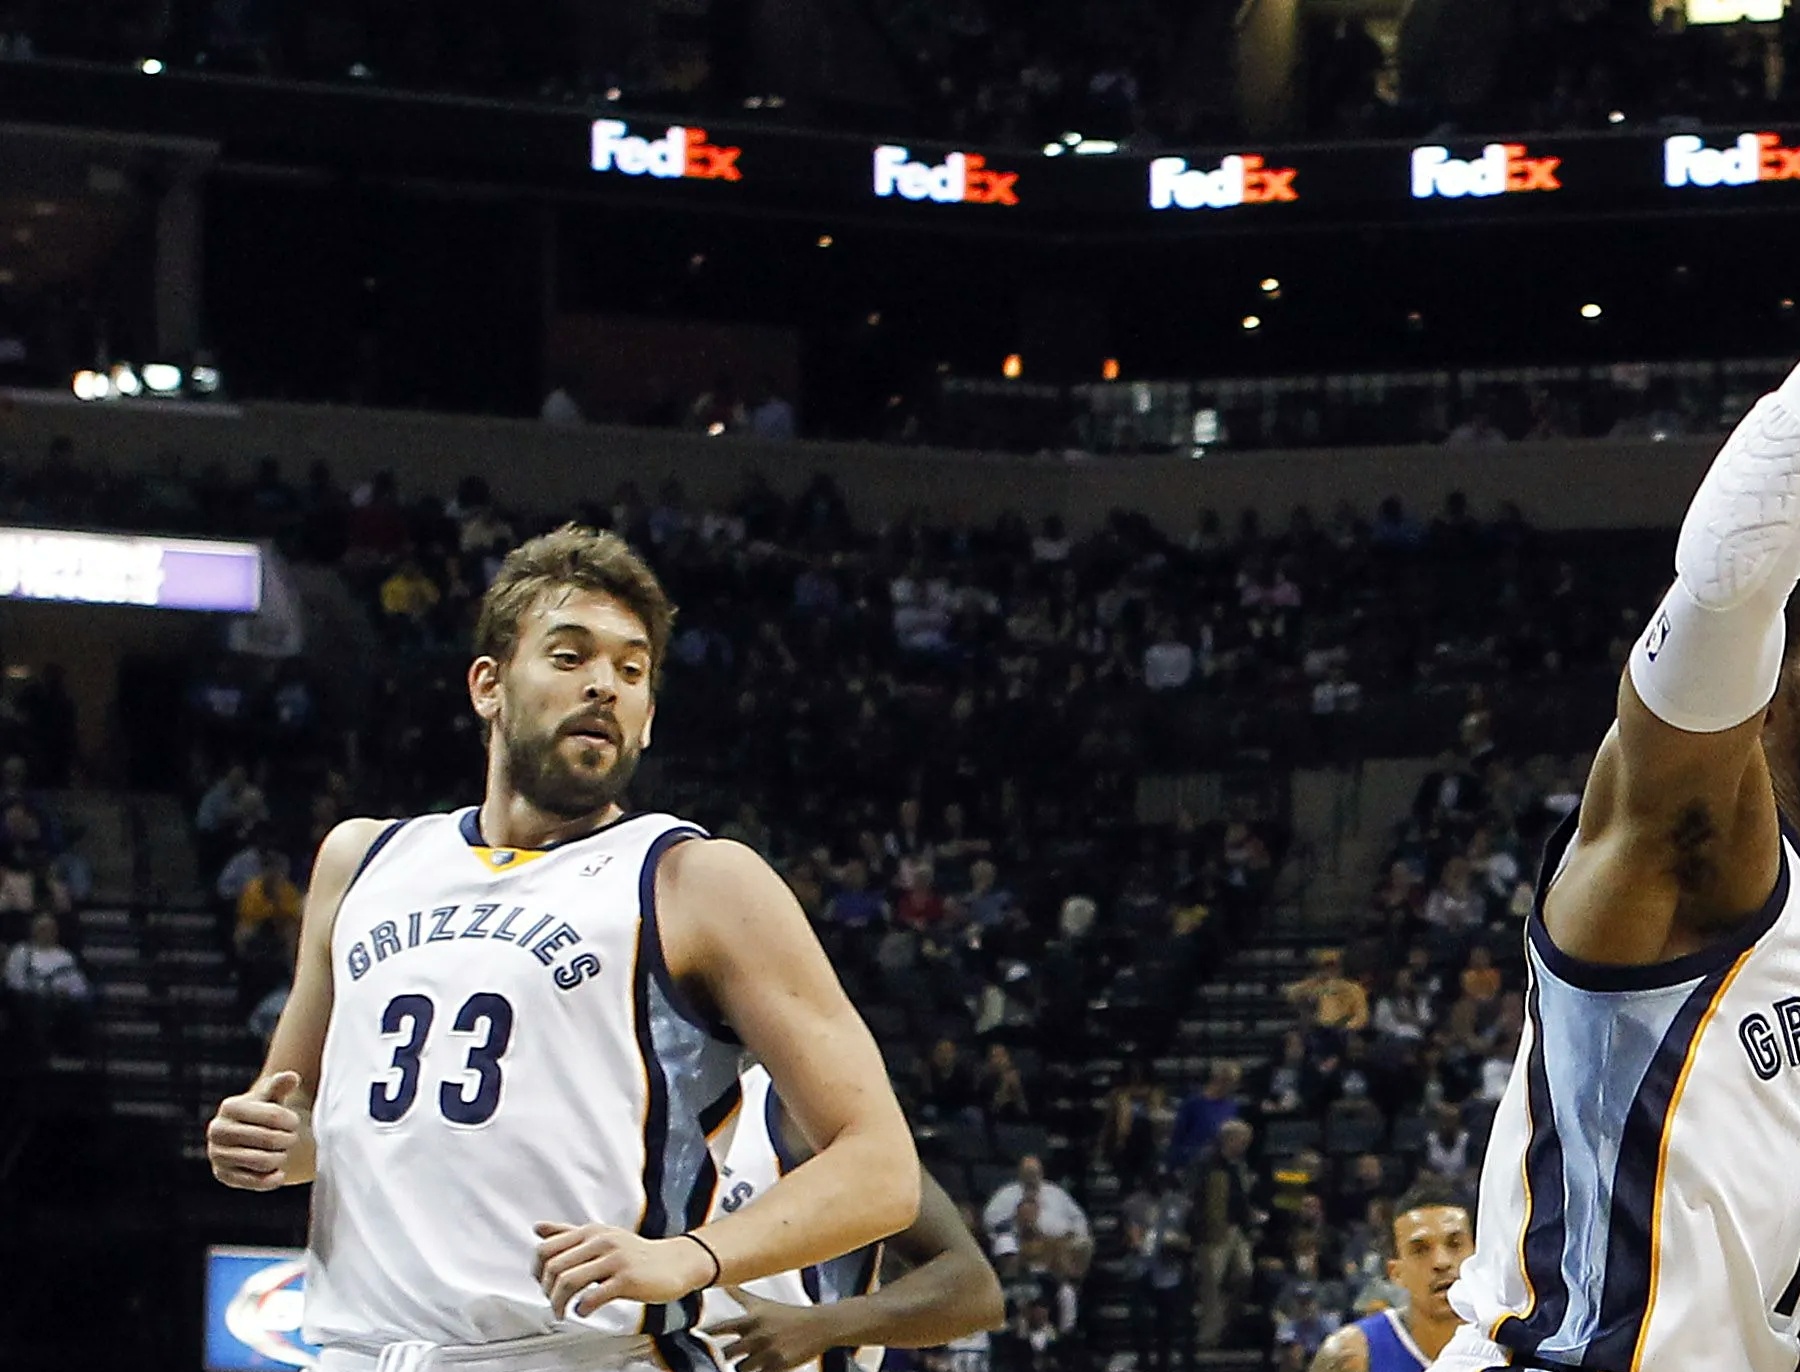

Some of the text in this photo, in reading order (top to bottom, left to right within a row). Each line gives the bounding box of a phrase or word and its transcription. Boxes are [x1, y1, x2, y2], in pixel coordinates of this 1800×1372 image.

[592, 120, 740, 180] FedEx
[874, 146, 1018, 205] FedEx
[1411, 144, 1560, 198] FedEx
[1150, 155, 1298, 209] FedEx
[347, 903, 601, 990] GRIZZLIES
[369, 993, 513, 1125] 33
